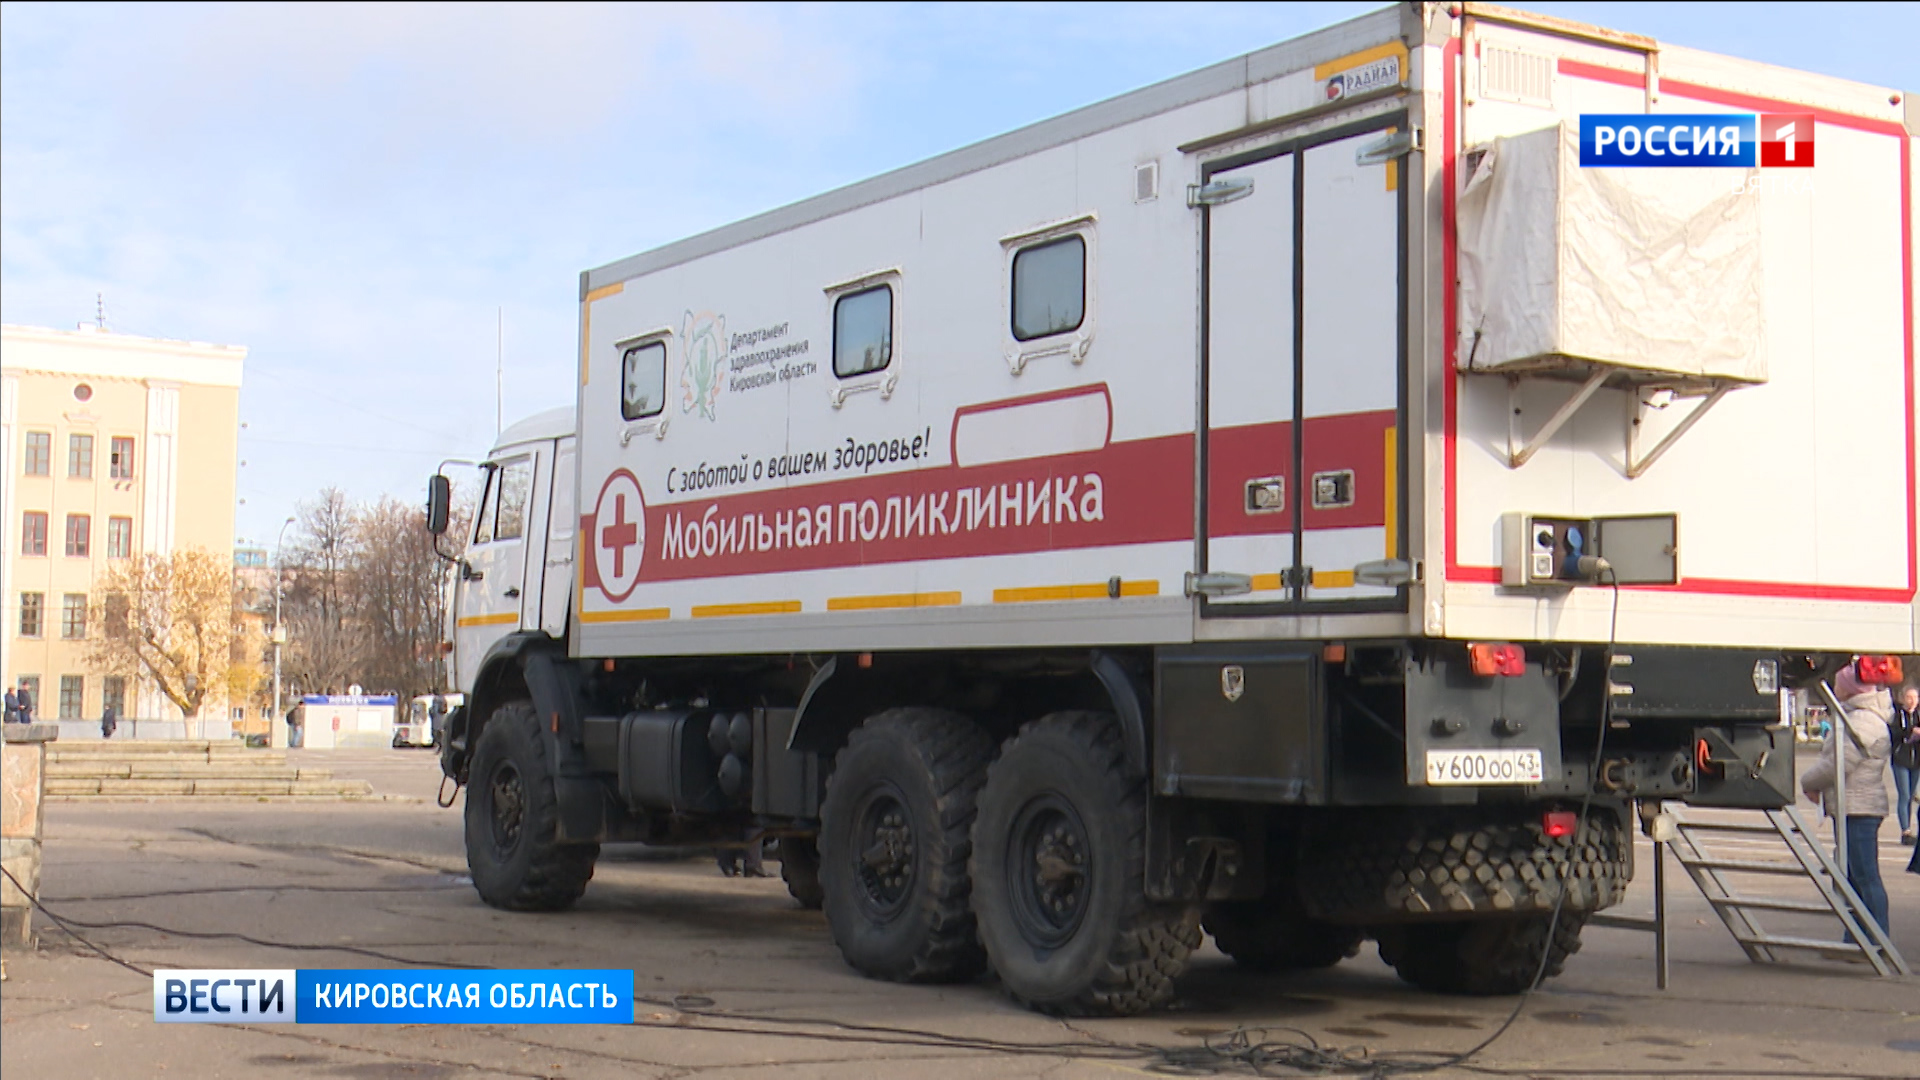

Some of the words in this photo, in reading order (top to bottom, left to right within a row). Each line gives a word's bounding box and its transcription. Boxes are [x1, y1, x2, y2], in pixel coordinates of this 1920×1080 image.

[730, 321, 789, 353] Департамент
[730, 339, 809, 373] здравоохранения
[729, 370, 777, 393] Кировской
[778, 362, 817, 381] области
[667, 467, 676, 493] С
[680, 454, 748, 493] заботой
[752, 460, 763, 480] о
[767, 449, 827, 480] вашем
[833, 426, 931, 473] здоровье!
